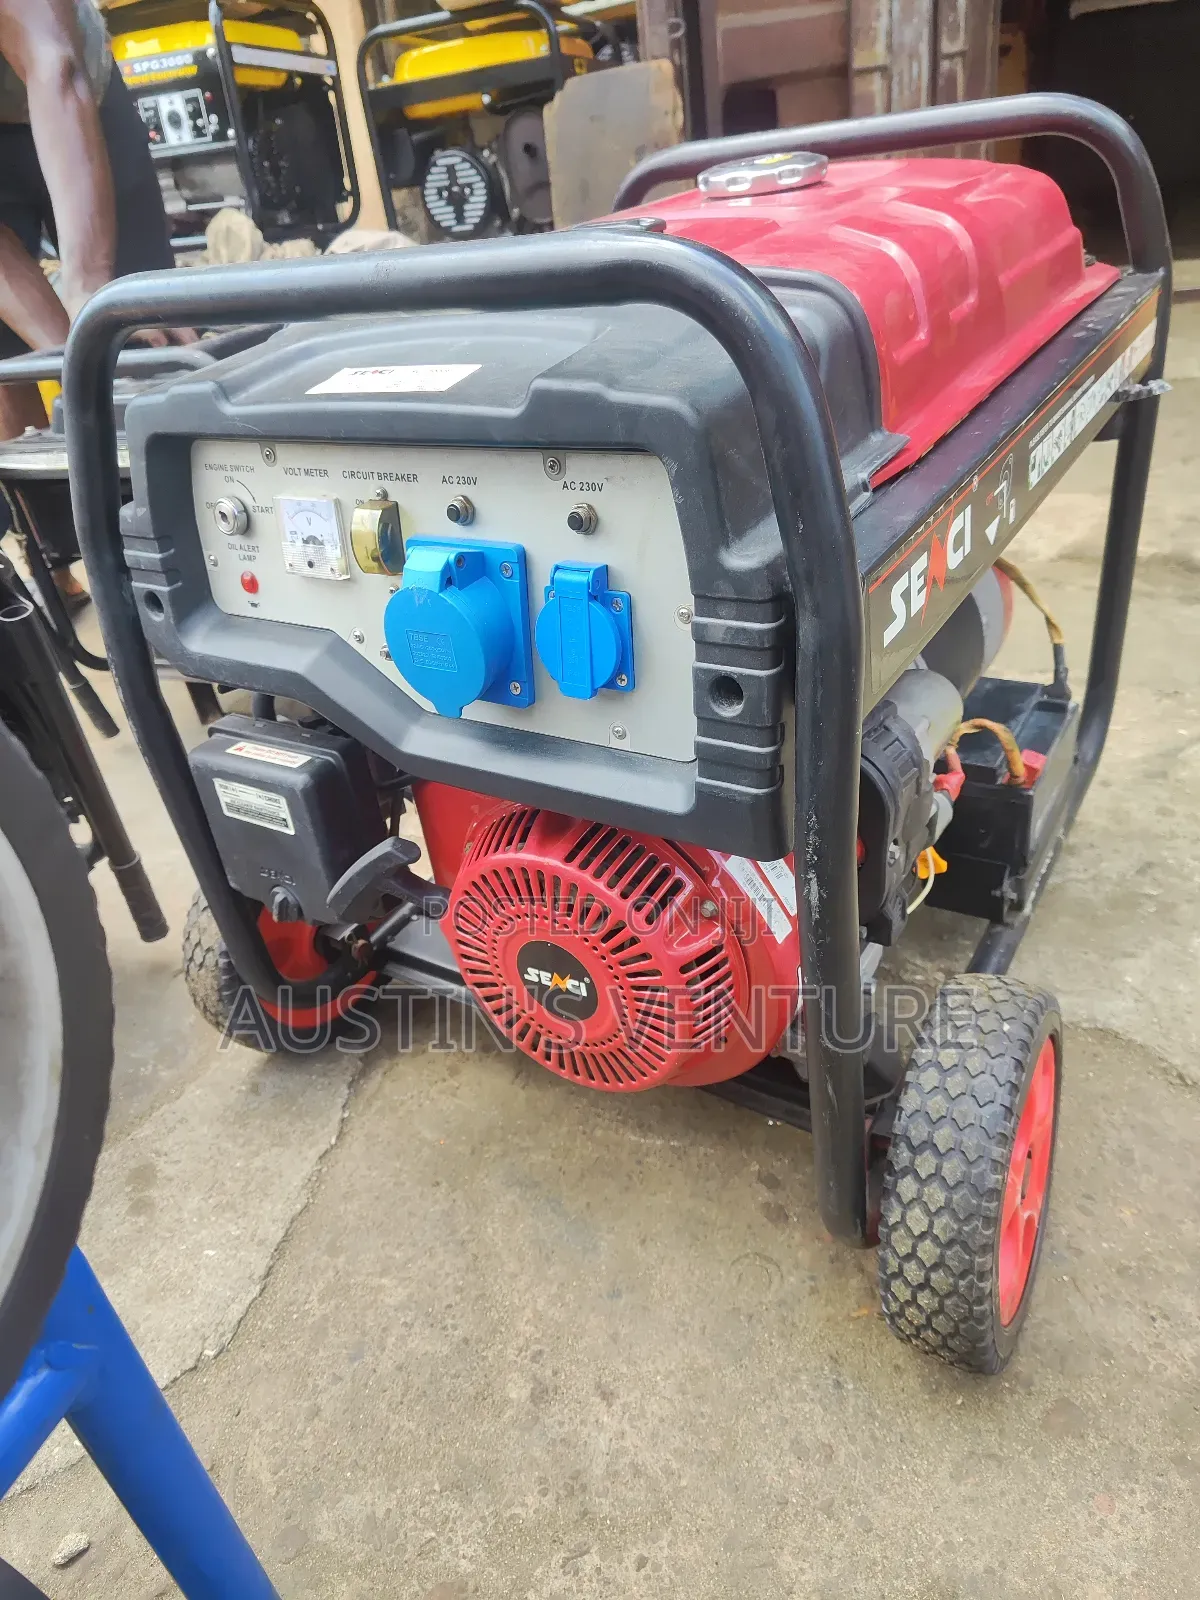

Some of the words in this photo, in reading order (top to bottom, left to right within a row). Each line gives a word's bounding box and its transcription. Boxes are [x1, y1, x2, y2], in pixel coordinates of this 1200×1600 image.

[204, 463, 228, 472] ENGINE
[230, 464, 255, 473] SWITCH
[283, 467, 301, 477] VOLT
[303, 468, 329, 478] METER
[224, 475, 235, 484] ON
[342, 470, 375, 481] CIRCUIT
[377, 471, 419, 483] BREAKER
[441, 475, 454, 485] AC
[456, 476, 478, 486] 230V
[562, 480, 577, 491] AC
[579, 481, 604, 492] 230V
[252, 505, 274, 515] START
[227, 542, 238, 551] OIL
[239, 544, 260, 553] ALERT
[238, 554, 257, 563] LAMP
[883, 503, 972, 649] SENCI
[523, 966, 588, 998] SENCI
